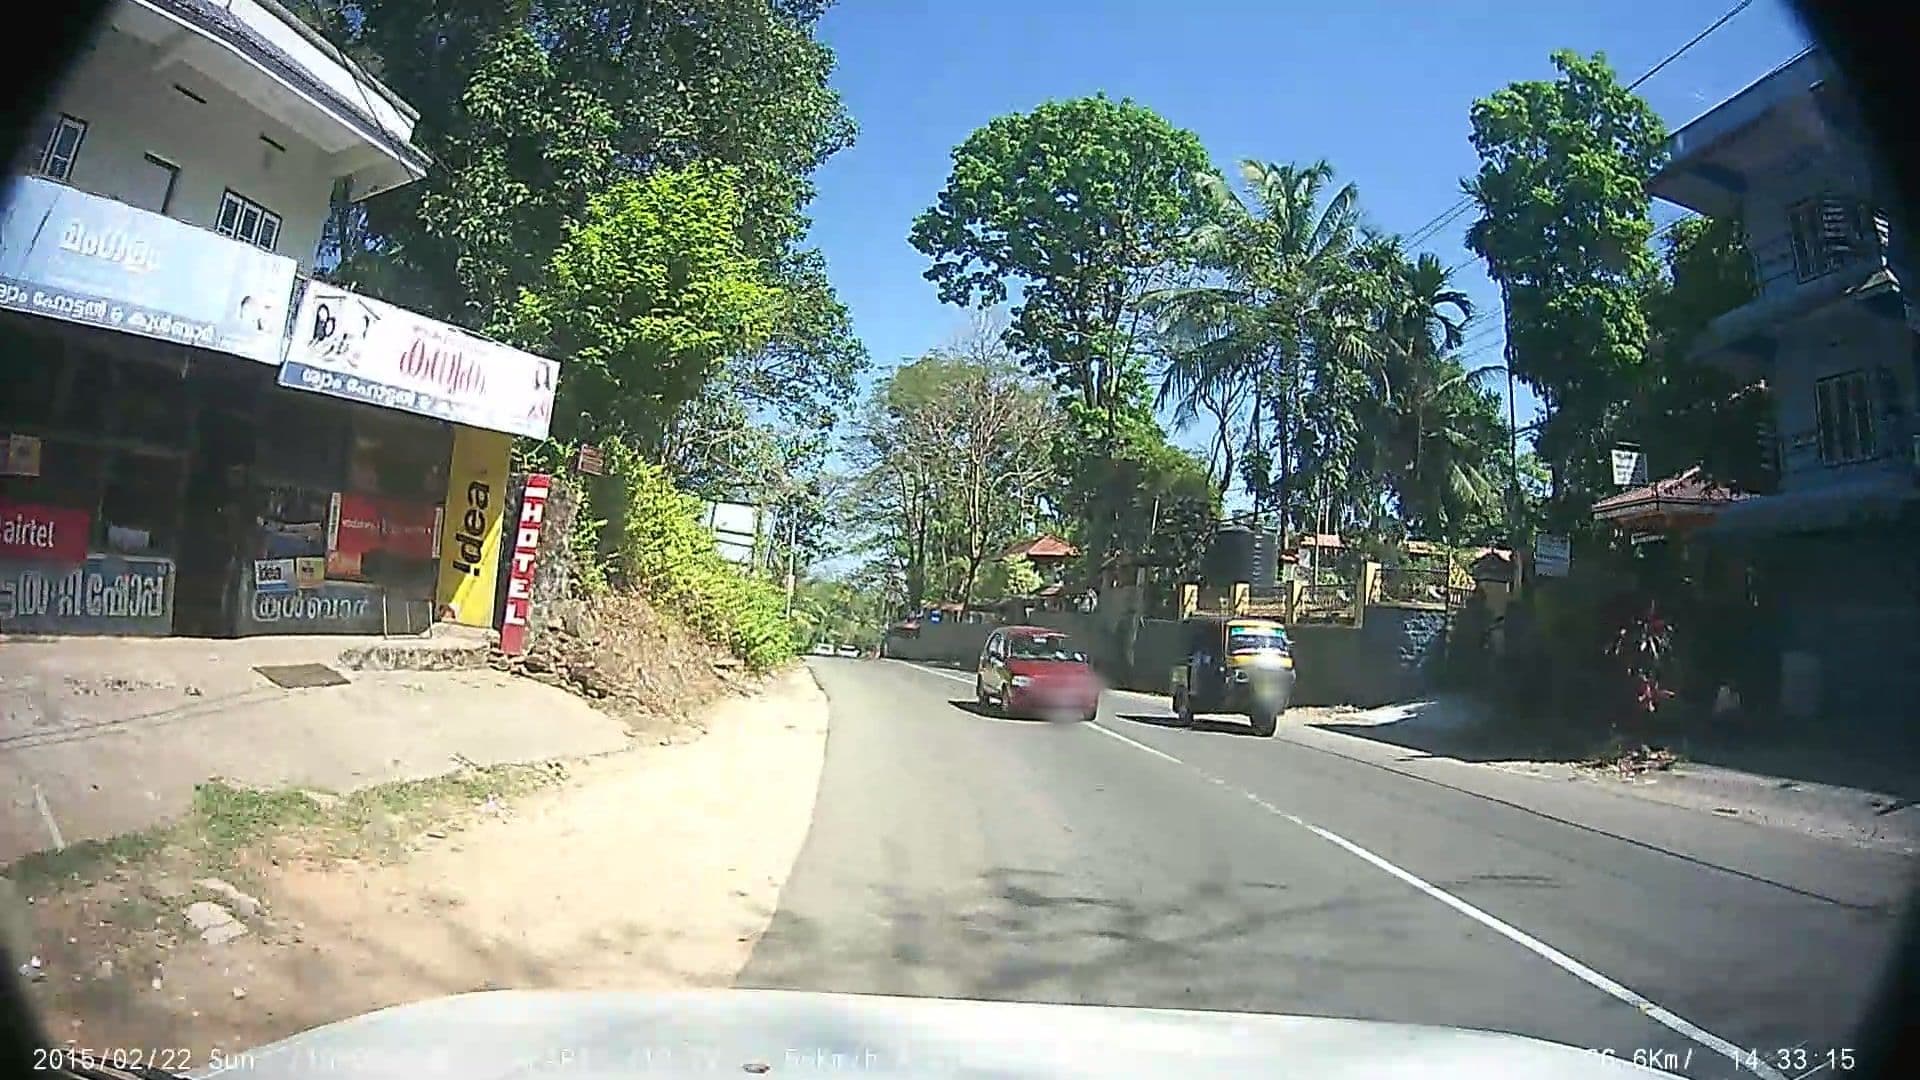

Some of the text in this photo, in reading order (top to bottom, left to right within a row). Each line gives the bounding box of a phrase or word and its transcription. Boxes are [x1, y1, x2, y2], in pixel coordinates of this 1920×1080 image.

[3, 514, 55, 547] airtel
[453, 481, 490, 577] idea
[505, 502, 544, 626] HOTEL
